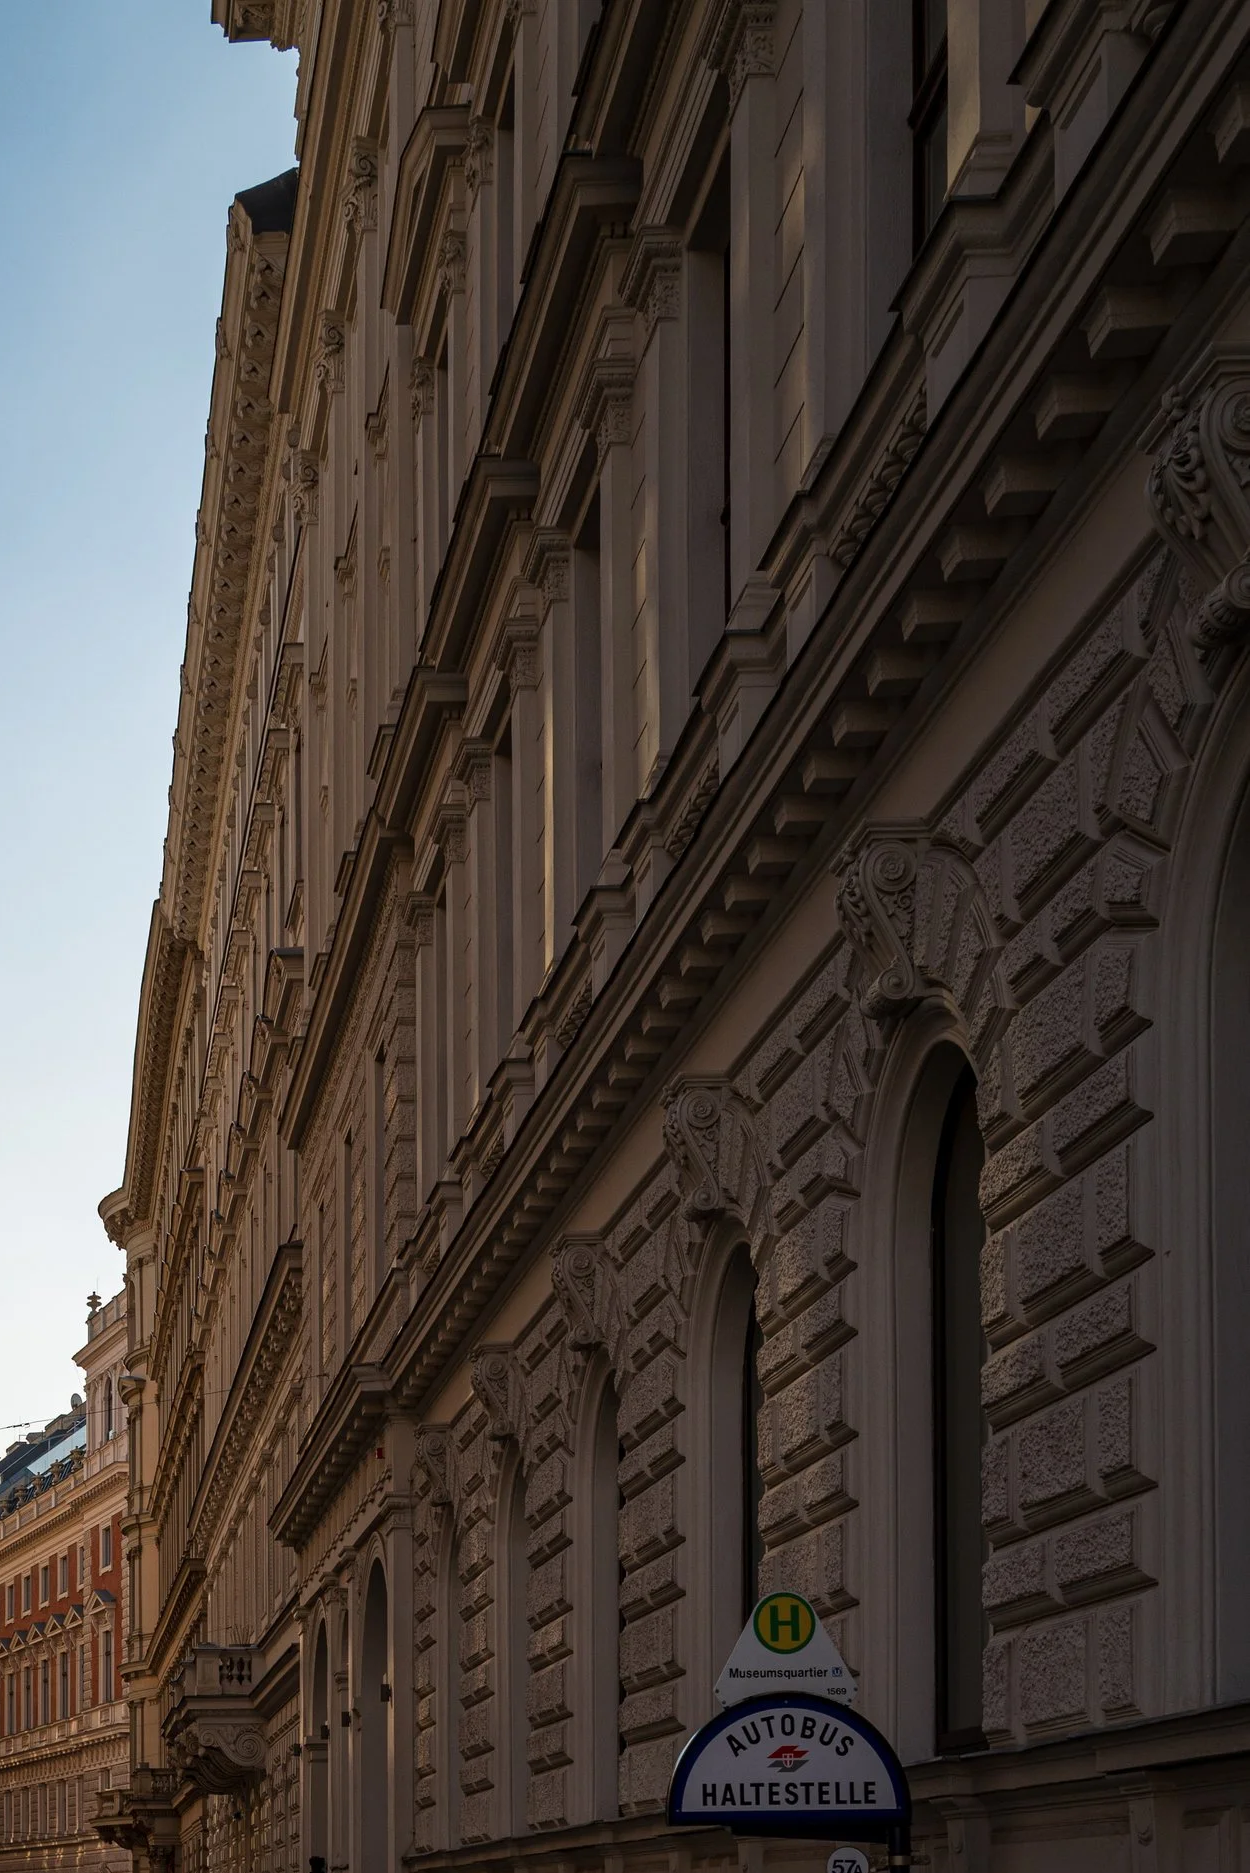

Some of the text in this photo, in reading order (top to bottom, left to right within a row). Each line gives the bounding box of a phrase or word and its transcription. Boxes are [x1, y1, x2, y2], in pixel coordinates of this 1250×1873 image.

[770, 1605, 800, 1641] H
[729, 1667, 829, 1680] Museumsquartier
[827, 1687, 847, 1695] 1569
[726, 1714, 854, 1757] AUTOBUS
[702, 1782, 876, 1806] HALTESTELLE
